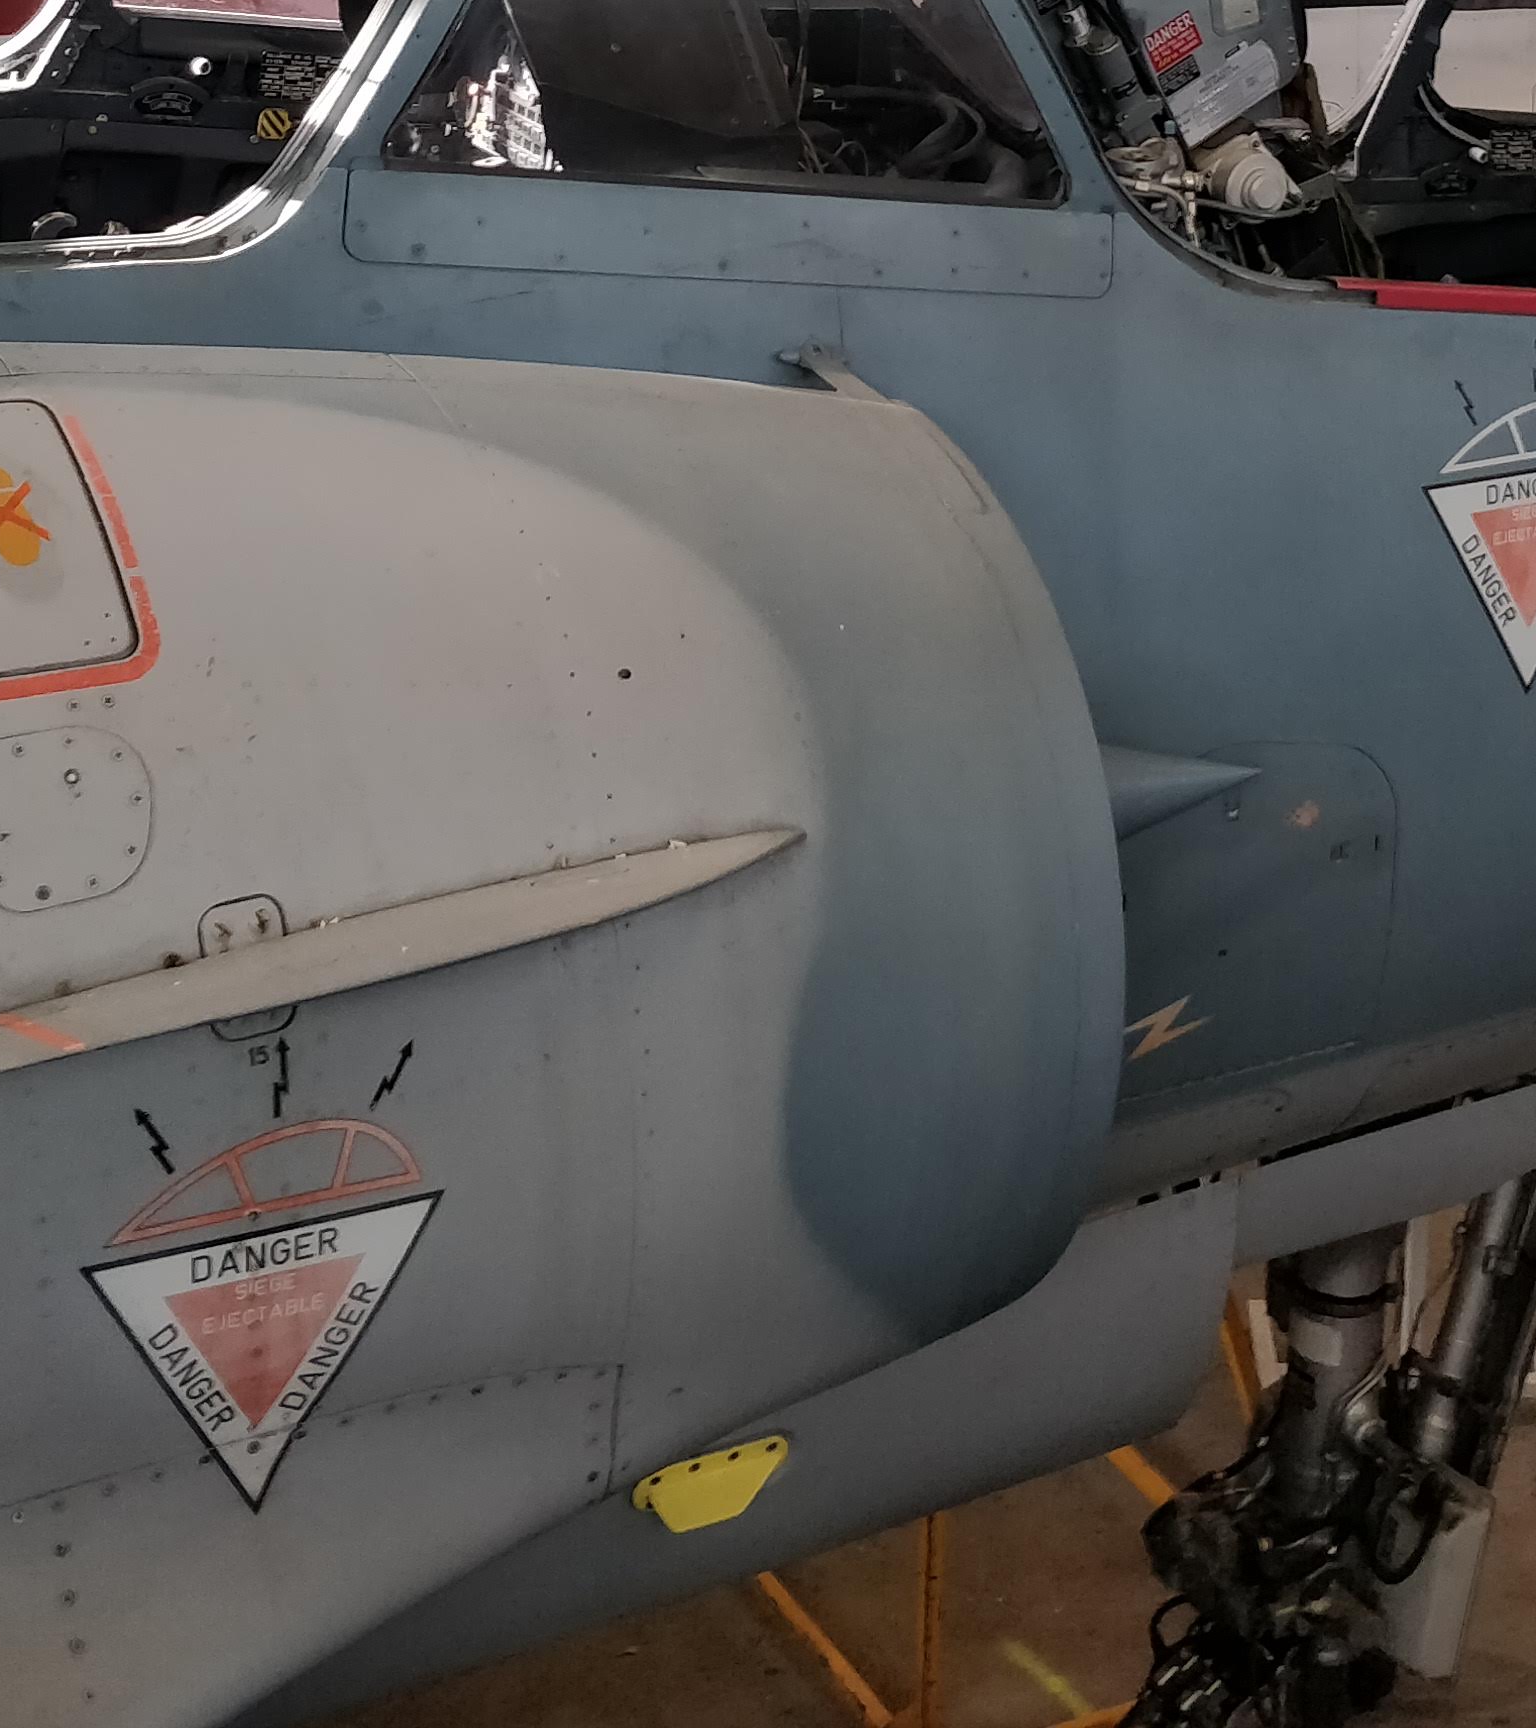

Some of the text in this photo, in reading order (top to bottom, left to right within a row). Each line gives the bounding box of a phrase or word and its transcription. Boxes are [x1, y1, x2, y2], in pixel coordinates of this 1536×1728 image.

[1144, 12, 1195, 53] DANGER
[1461, 533, 1516, 627] DANGER
[190, 1227, 339, 1284] DANGER
[202, 1292, 325, 1335] EJECTABLE
[235, 1272, 296, 1300] SIEGE
[281, 1280, 379, 1413] DANGER
[148, 1323, 236, 1433] DANGER
